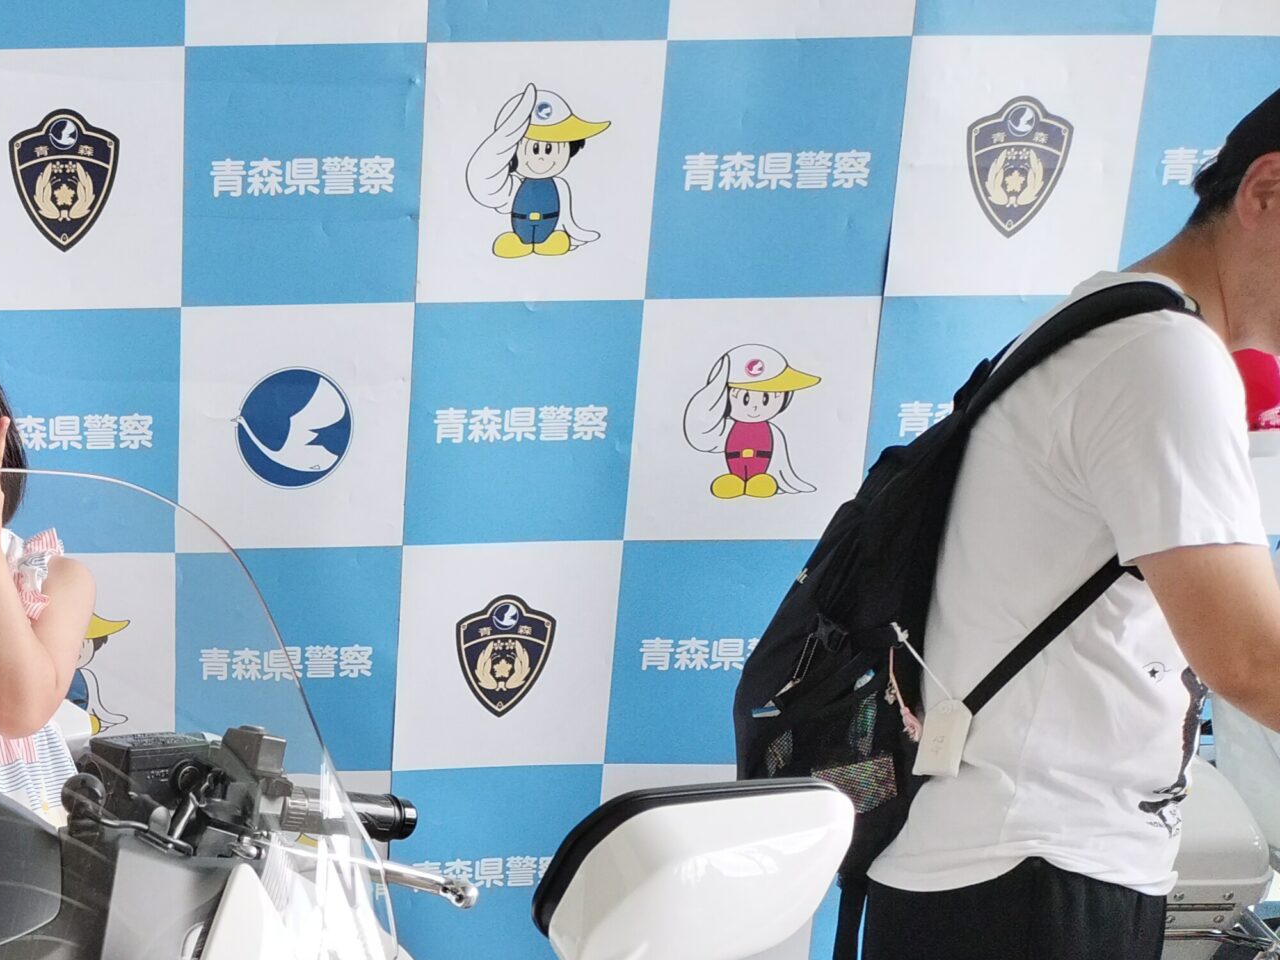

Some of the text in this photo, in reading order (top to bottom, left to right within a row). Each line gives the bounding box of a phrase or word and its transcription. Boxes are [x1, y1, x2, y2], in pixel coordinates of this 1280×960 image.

[210, 156, 396, 198] 青森県警察
[681, 148, 871, 193] 青森県警察
[433, 404, 609, 445] 青森県警察
[199, 644, 373, 682] 青森県警察
[639, 637, 761, 671] 青森県
